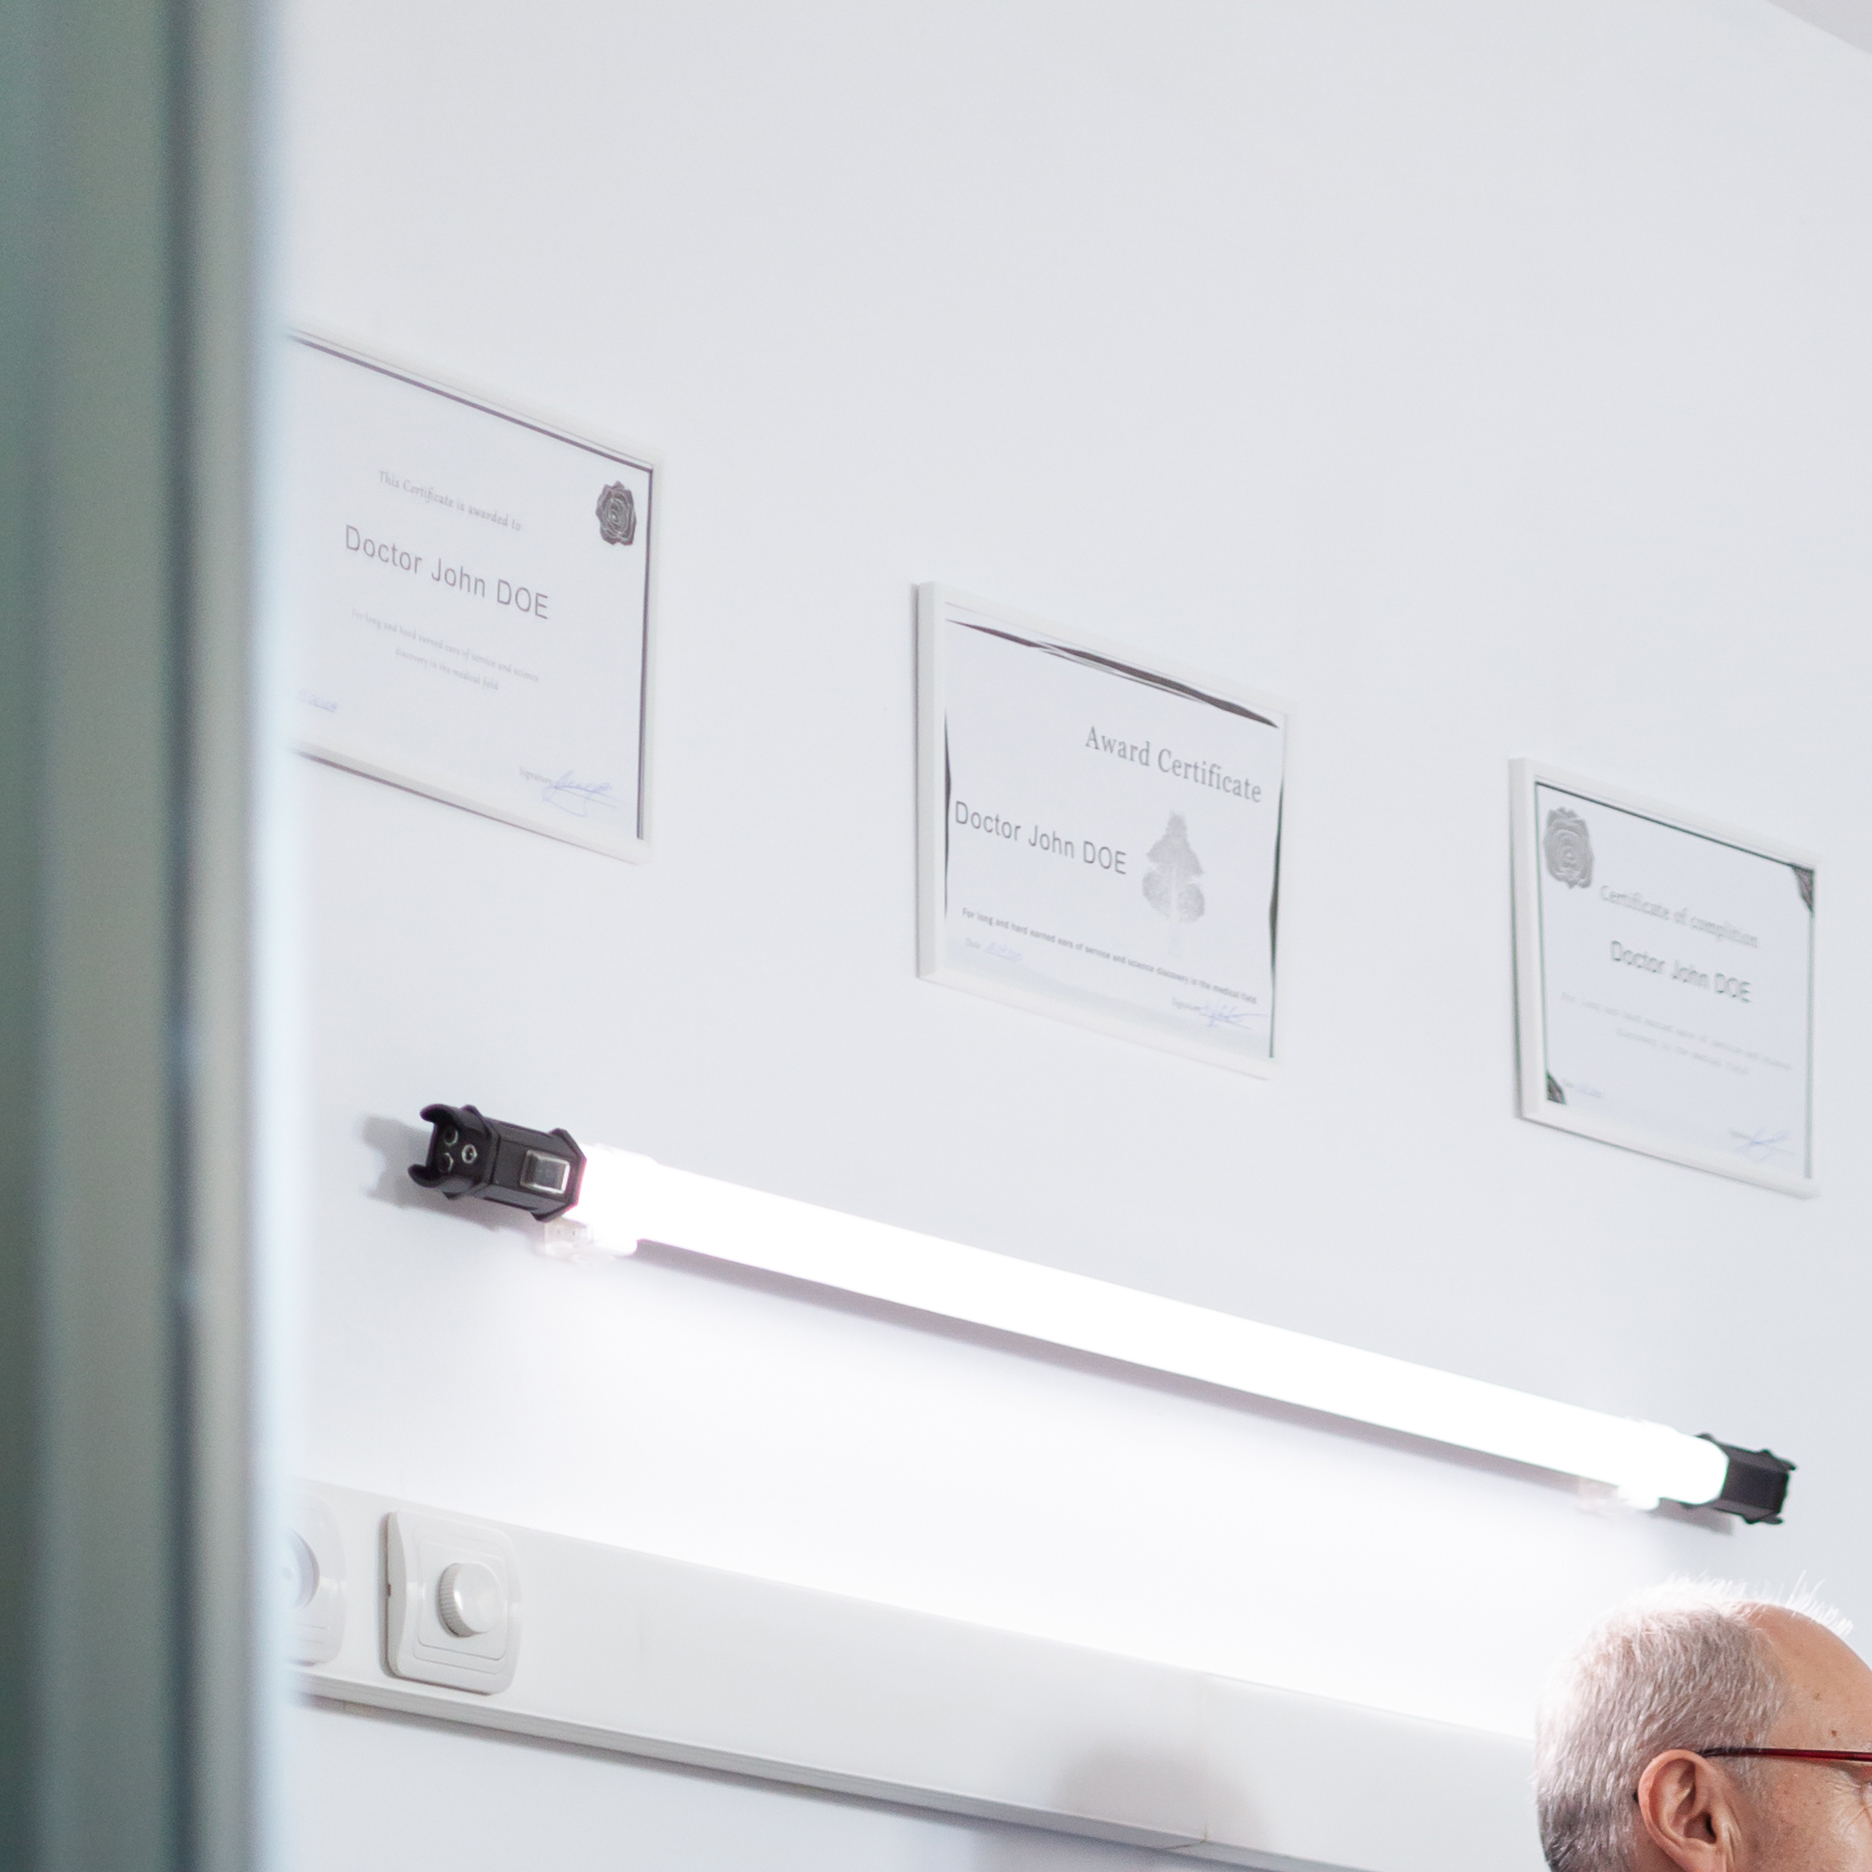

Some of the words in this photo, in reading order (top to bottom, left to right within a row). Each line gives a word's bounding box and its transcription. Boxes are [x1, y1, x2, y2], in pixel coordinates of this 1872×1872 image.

[379, 470, 400, 489] This
[403, 479, 454, 507] Certificate
[456, 497, 464, 511] is
[468, 503, 508, 527] awarded
[511, 515, 522, 531] to
[346, 524, 423, 574] Doctor
[431, 558, 485, 597] John
[497, 579, 548, 620] DOE
[1085, 725, 1150, 766] Award
[1158, 748, 1262, 803] Certificate
[955, 801, 1022, 841] Doctor
[1028, 825, 1074, 859] John
[1083, 841, 1127, 875] DOE
[1600, 885, 1670, 921] Certificate
[1611, 940, 1666, 974] Doctor
[1670, 959, 1710, 989] John
[1714, 972, 1752, 1003] DOE
